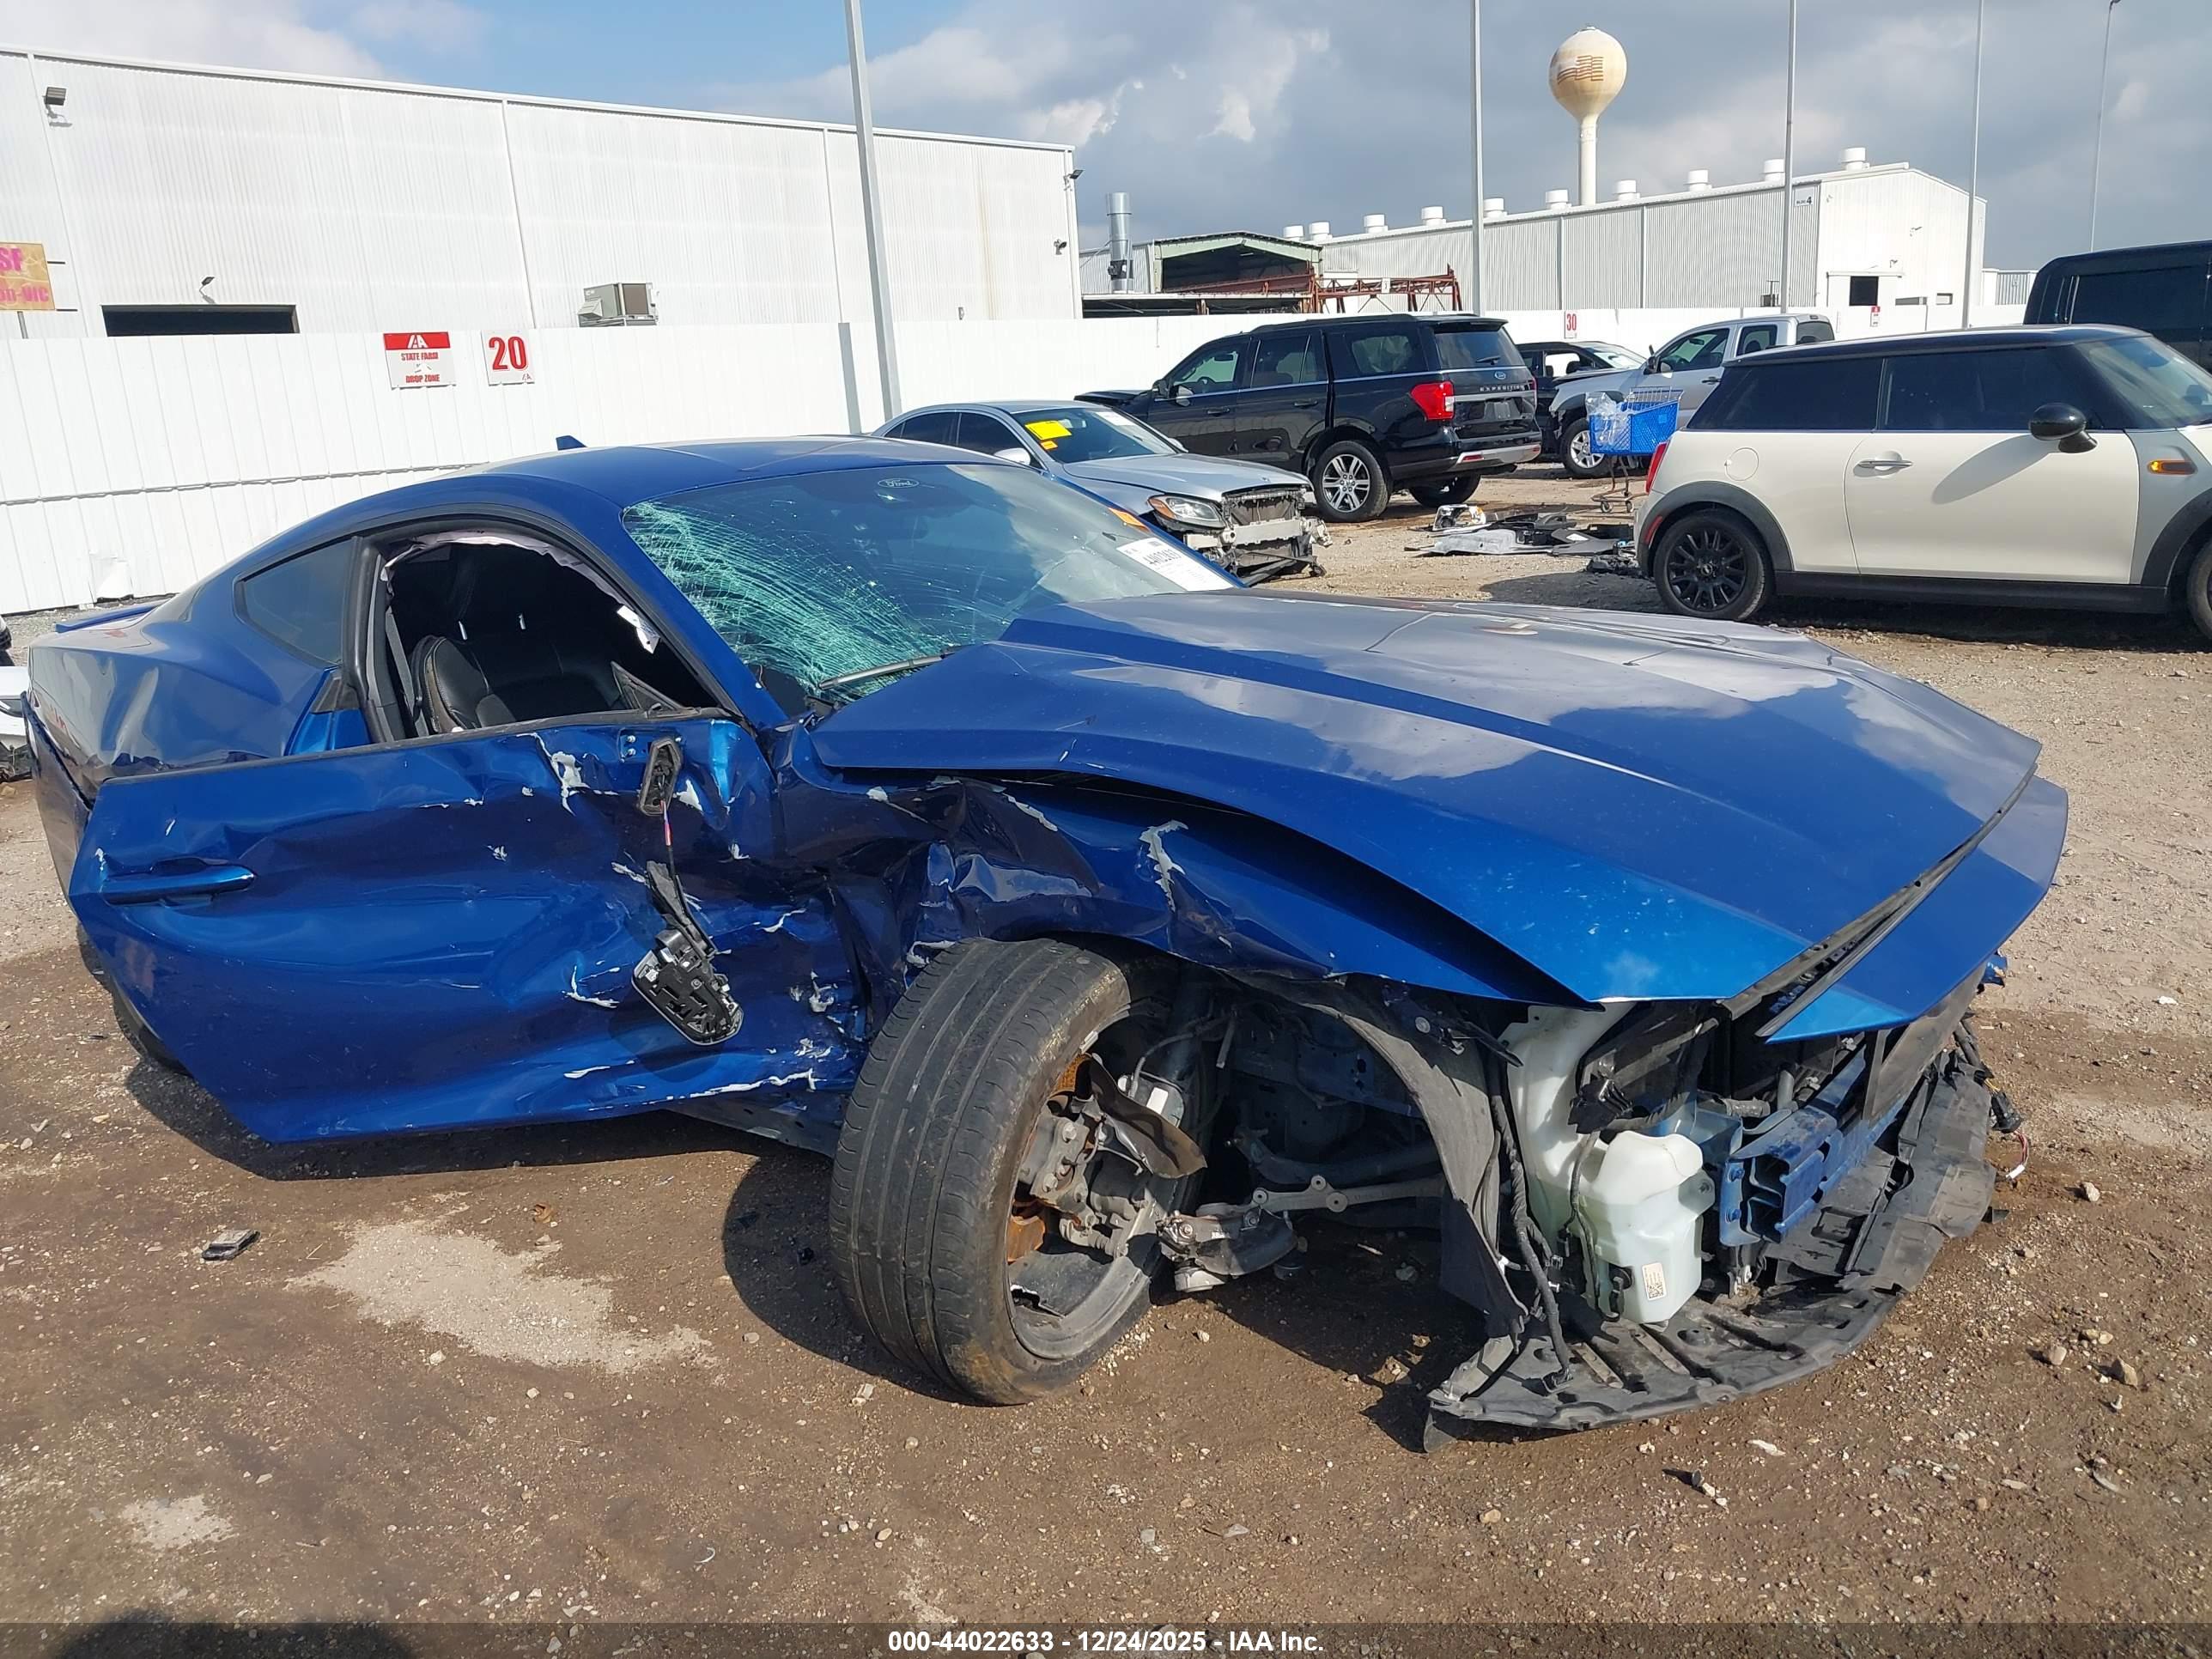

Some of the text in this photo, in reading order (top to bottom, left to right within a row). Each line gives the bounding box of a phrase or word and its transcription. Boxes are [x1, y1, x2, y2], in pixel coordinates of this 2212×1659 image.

[1566, 313, 1577, 331] 30
[401, 353, 420, 362] STATE
[488, 336, 529, 371] 20
[405, 374, 441, 384] DROP ZONE
